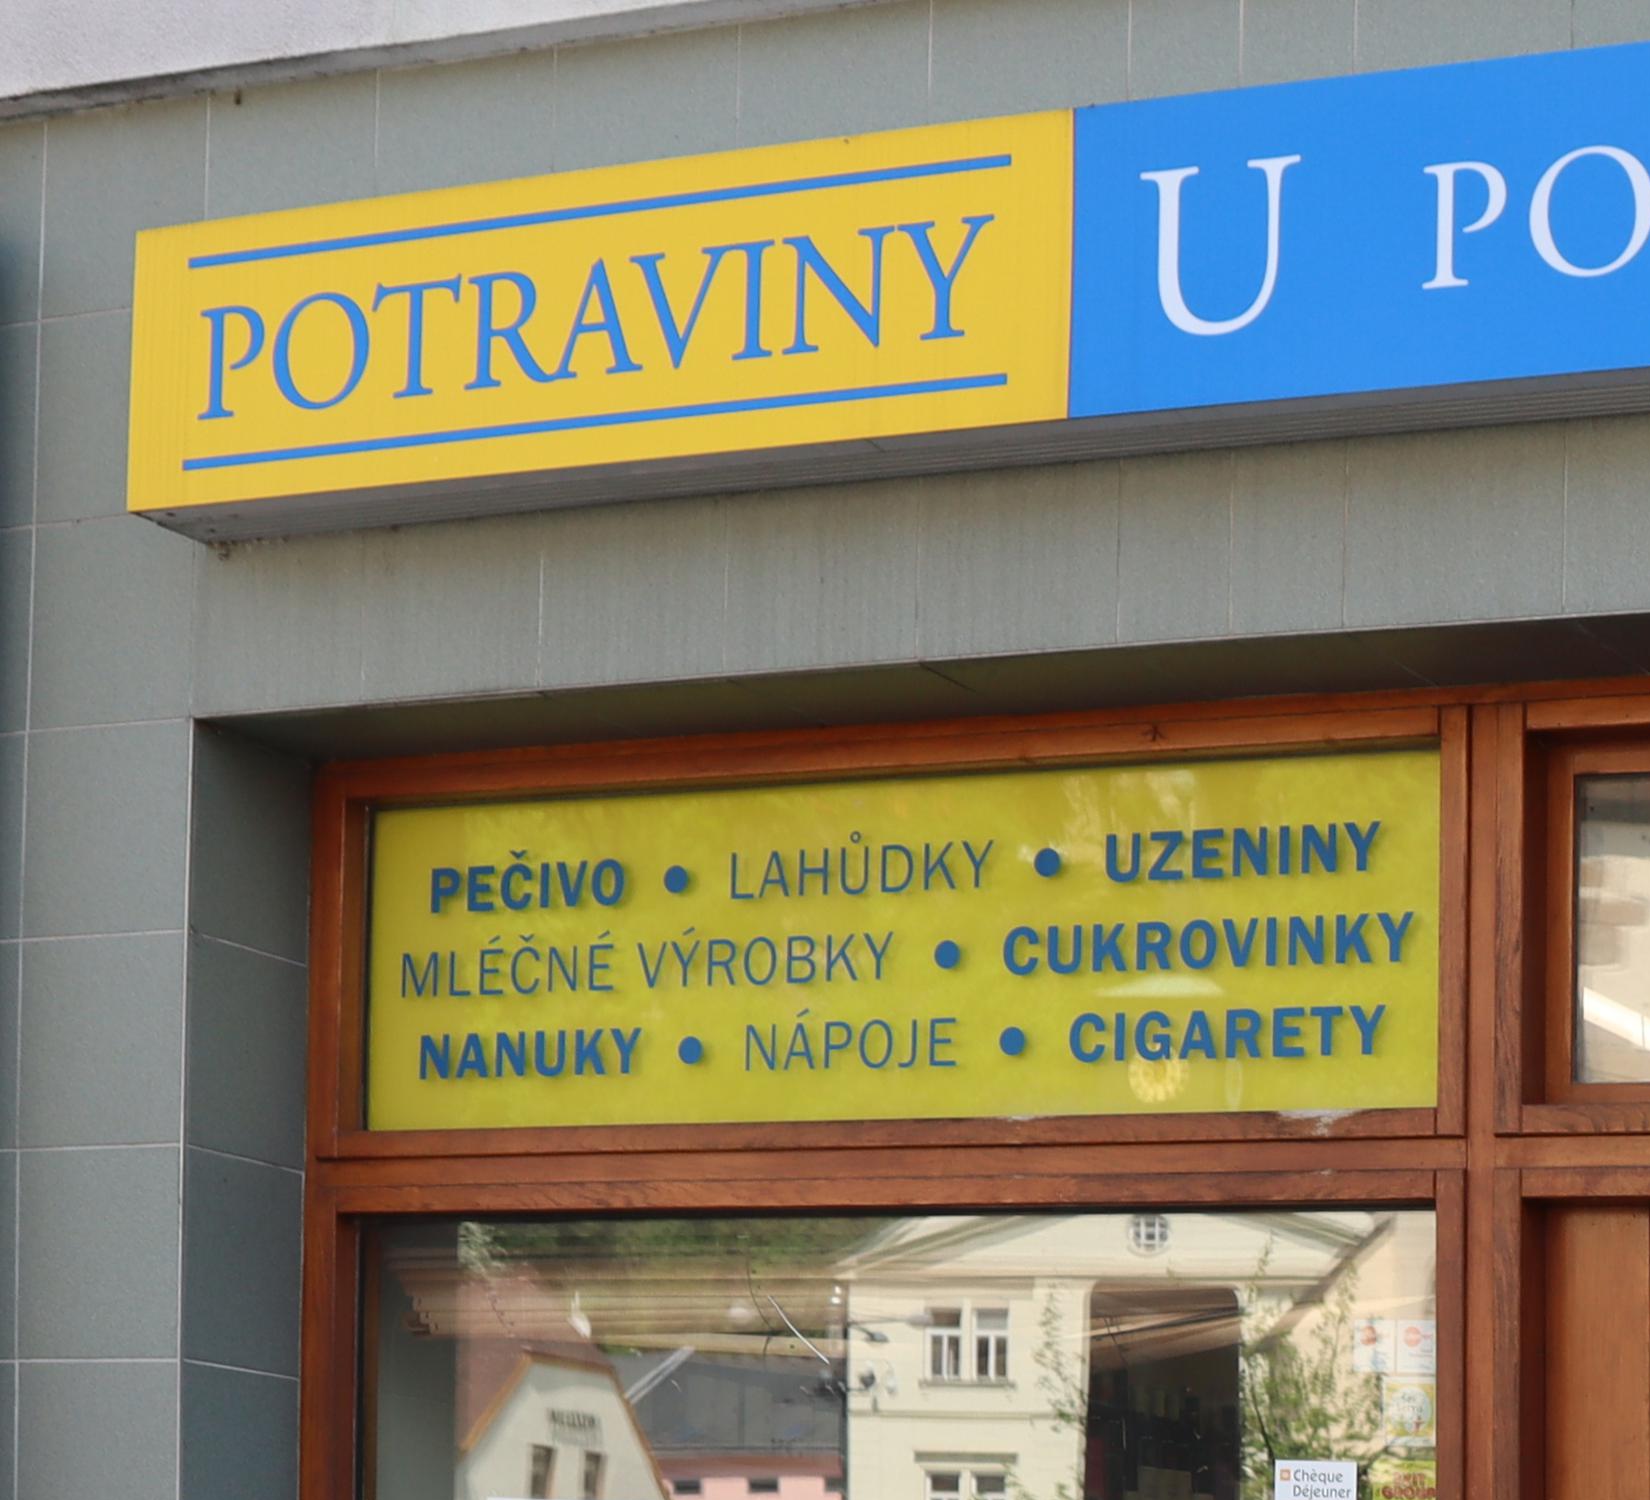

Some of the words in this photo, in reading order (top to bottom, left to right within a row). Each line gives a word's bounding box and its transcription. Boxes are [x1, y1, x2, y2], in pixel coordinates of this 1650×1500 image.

[196, 213, 995, 421] POTRAVINY
[1140, 154, 1302, 336] U
[430, 850, 626, 914] PEČIVO
[730, 831, 994, 901] LAHŮDKY
[1104, 821, 1381, 883] UZENINY
[401, 931, 615, 998] MLÉČNÉ
[637, 927, 894, 989] VÝROBKY
[1003, 911, 1415, 976] CUKROVINKY
[419, 1028, 642, 1081] NANUKY
[745, 1009, 958, 1071] NÁPOJE
[1069, 1005, 1386, 1064] CIGARETY
[1293, 1484, 1351, 1500] Déjeuner
[1294, 1469, 1343, 1487] Chèque
